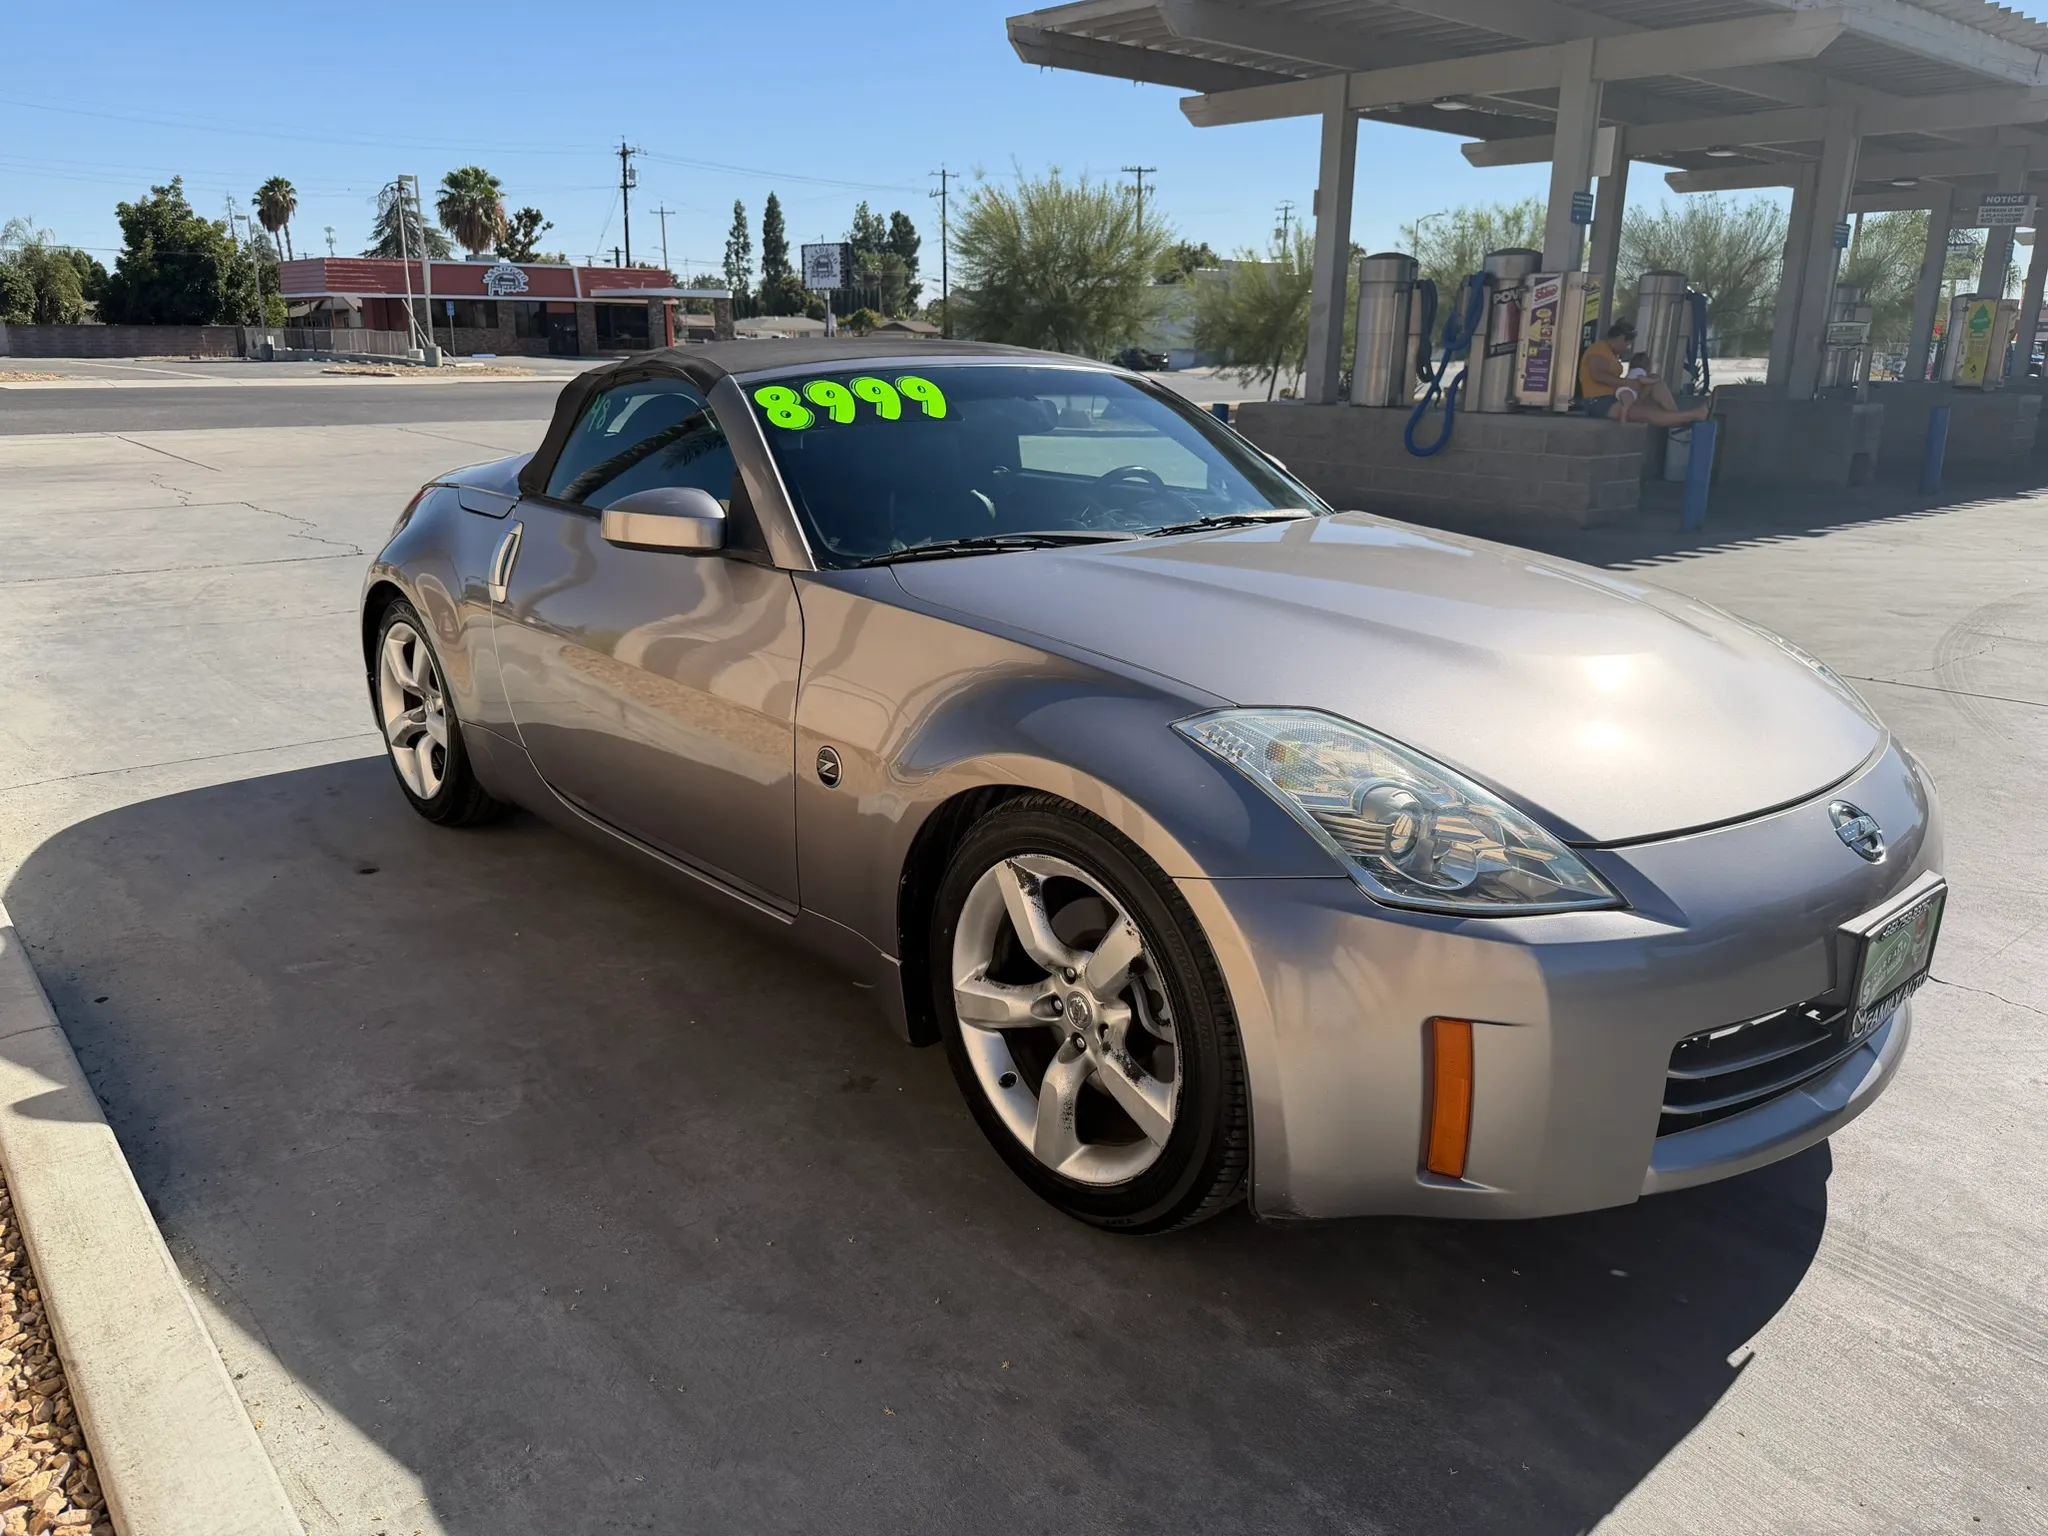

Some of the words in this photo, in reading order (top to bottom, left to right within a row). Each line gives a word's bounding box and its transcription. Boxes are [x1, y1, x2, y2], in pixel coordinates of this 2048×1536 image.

[1986, 195, 2024, 204] NOTICE
[754, 375, 947, 431] 8999
[1864, 987, 1903, 1032] FAMILY
[1902, 970, 1929, 1000] AUTO
